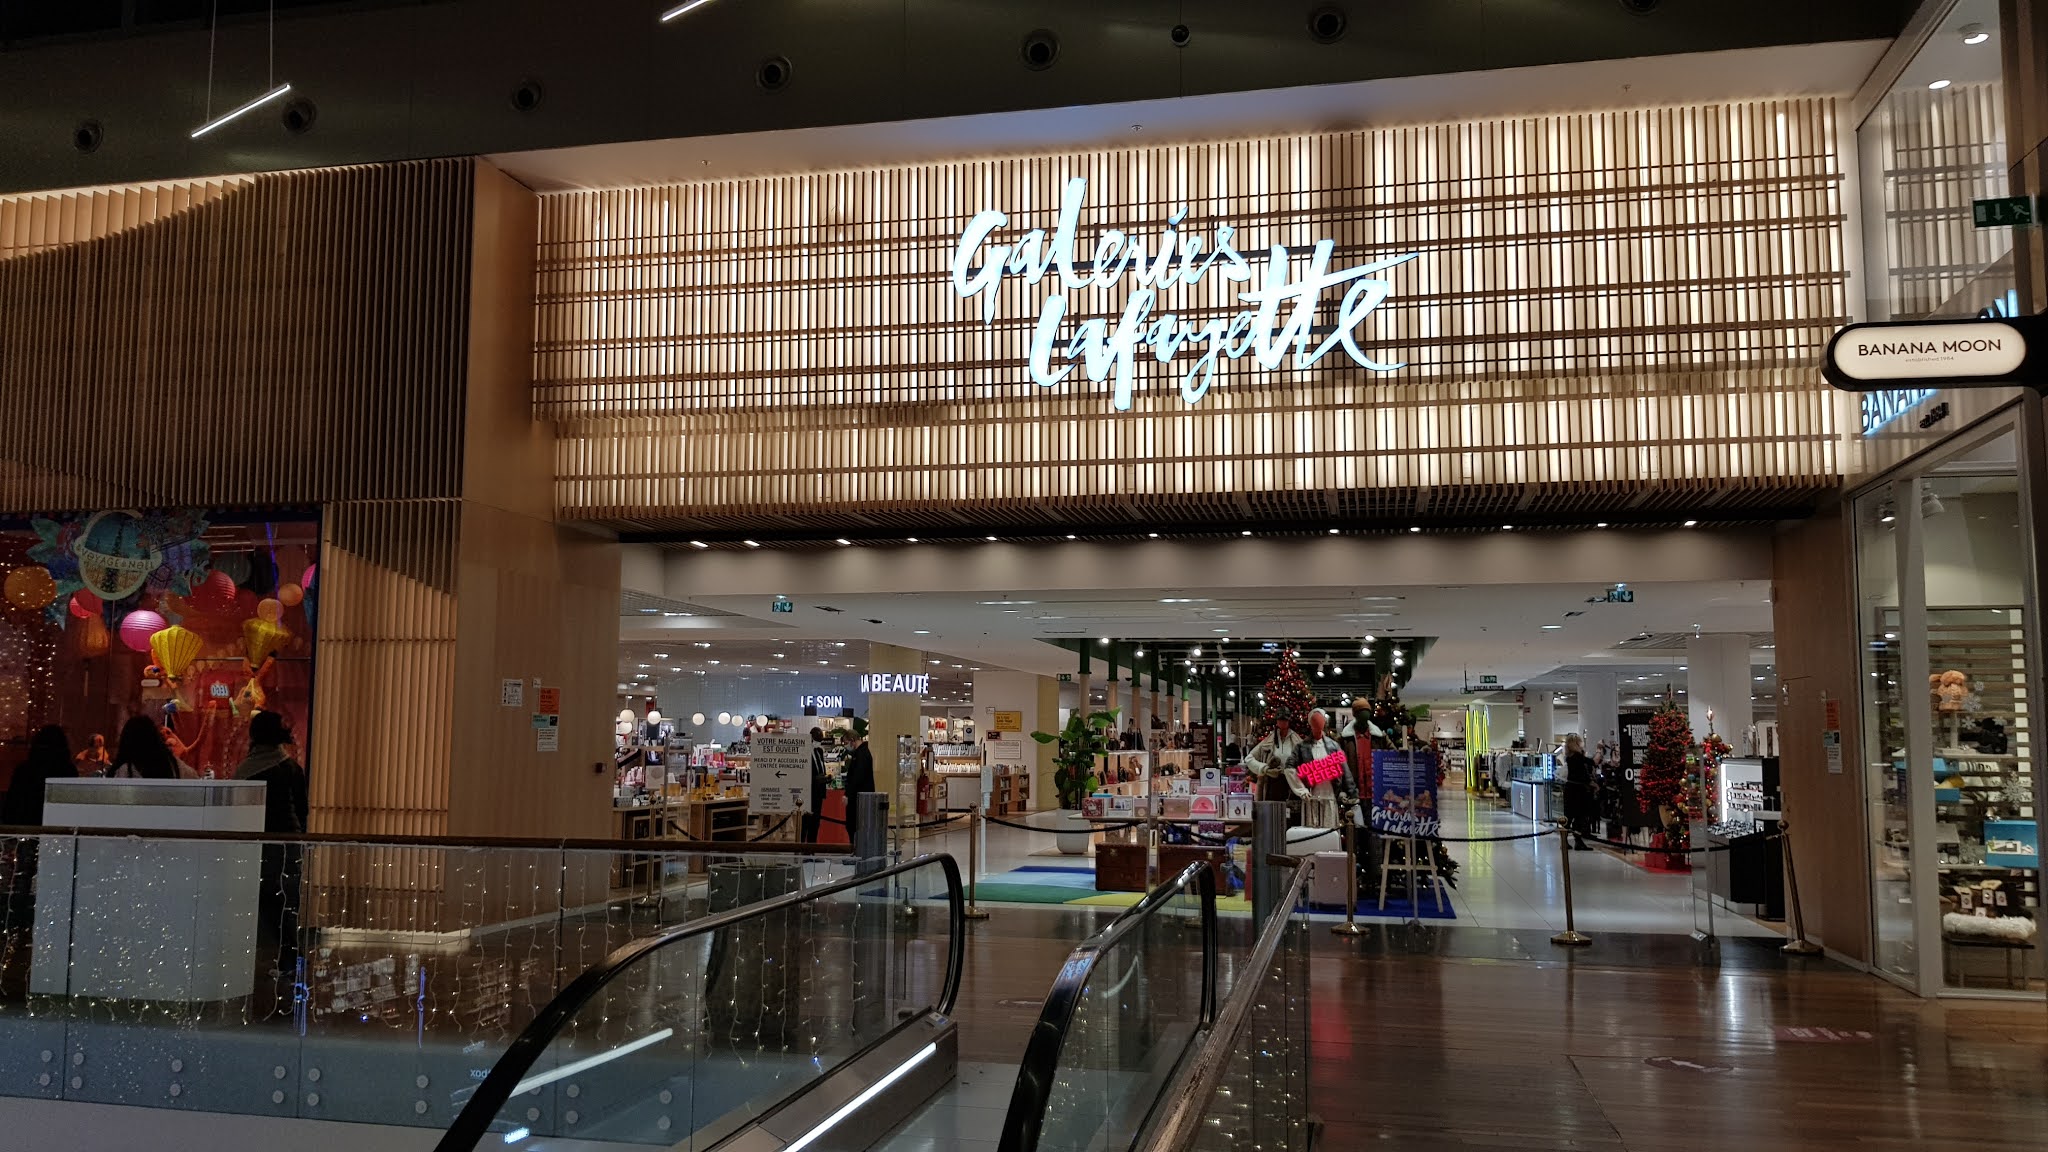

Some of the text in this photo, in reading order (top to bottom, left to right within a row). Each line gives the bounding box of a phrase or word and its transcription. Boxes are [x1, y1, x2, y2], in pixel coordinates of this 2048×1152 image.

[952, 178, 1252, 325] Galeries
[1029, 239, 1420, 411] Lafayette
[1858, 339, 2002, 356] BANANA MOON
[81, 548, 119, 567] VOYAGE
[871, 672, 929, 694] BEAUTÉ
[817, 695, 843, 708] SOIN
[1296, 750, 1347, 778] JOYEUSES
[1624, 768, 1633, 781] 0
